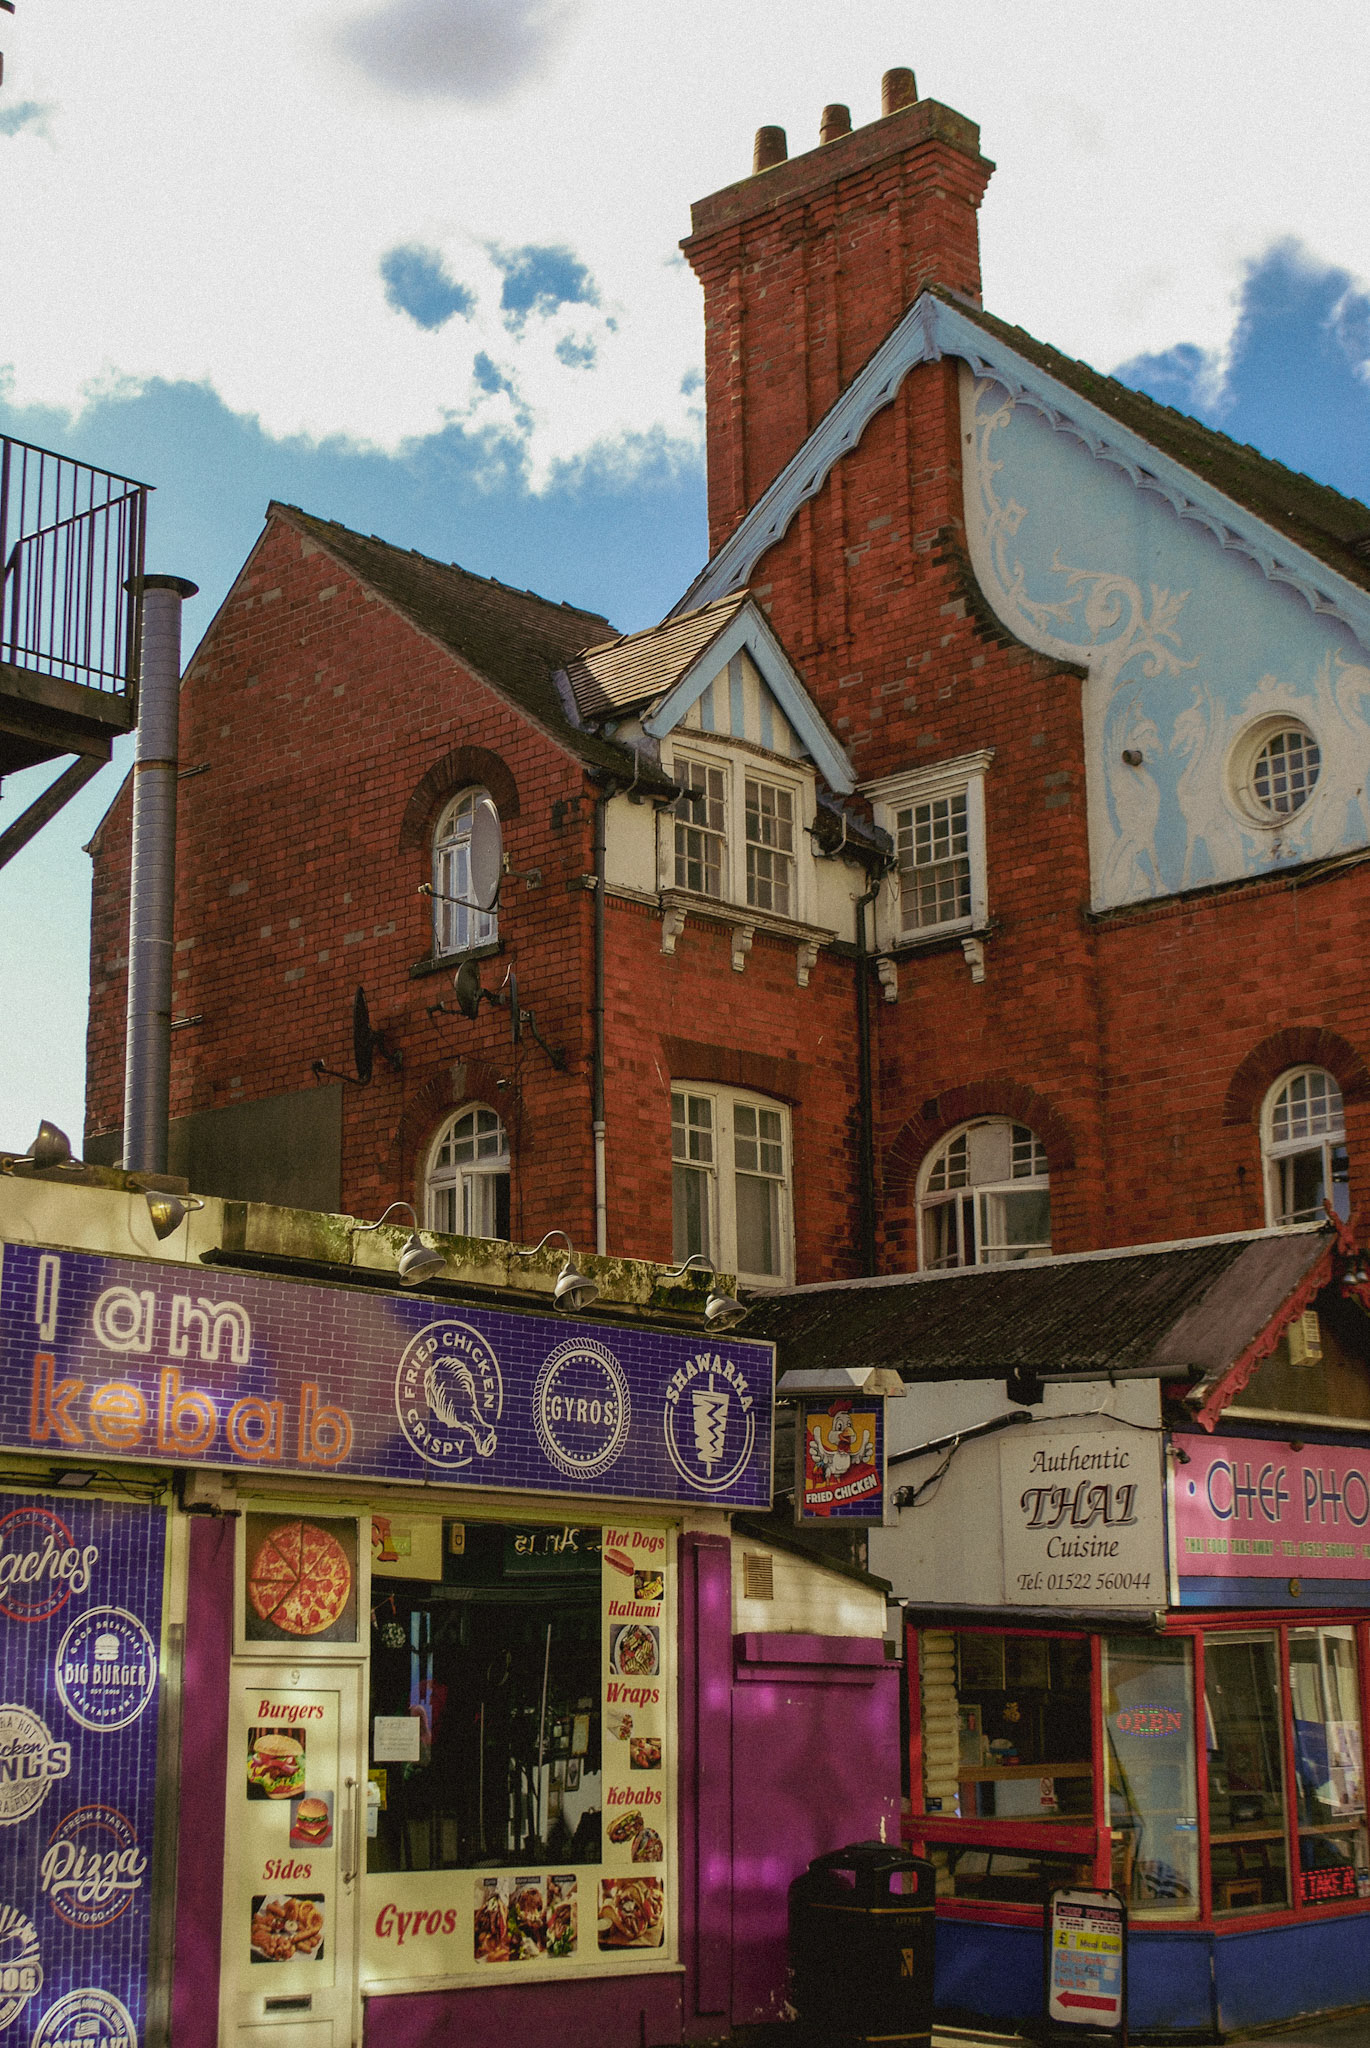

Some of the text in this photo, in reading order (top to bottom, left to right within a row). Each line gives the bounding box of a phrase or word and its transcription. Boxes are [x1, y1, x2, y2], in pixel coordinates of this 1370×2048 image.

[35, 1255, 250, 1363] I am
[404, 1332, 495, 1409] FRIED CHICKEN
[666, 1353, 753, 1412] SHAWARMA
[30, 1353, 352, 1465] kebab
[551, 1396, 614, 1425] GYROS
[407, 1408, 464, 1456] CRISPY
[1030, 1445, 1130, 1473] Authentic
[806, 1474, 877, 1504] FRIED CHICKEN
[1206, 1459, 1290, 1523] CHEF
[1020, 1480, 1137, 1530] THAI
[606, 1530, 629, 1548] Hot
[632, 1532, 665, 1552] Dogs
[1046, 1535, 1119, 1558] Cuisine
[0, 1533, 98, 1600] achos
[1017, 1572, 1150, 1590] Tel: 01522 560044
[608, 1601, 661, 1618] Hallumi
[71, 1627, 92, 1654] GOOD
[65, 1663, 146, 1686] BIG BURGER
[607, 1683, 659, 1708] Wraps
[257, 1700, 324, 1723] Burgers
[1116, 1713, 1183, 1731] OPEN
[607, 1787, 662, 1805] Kebabs
[64, 1811, 93, 1833] FRESH
[105, 1815, 131, 1838] TASTY
[41, 1840, 147, 1902] Pizza
[262, 1859, 312, 1880] Sides
[375, 1903, 457, 1945] Gyros
